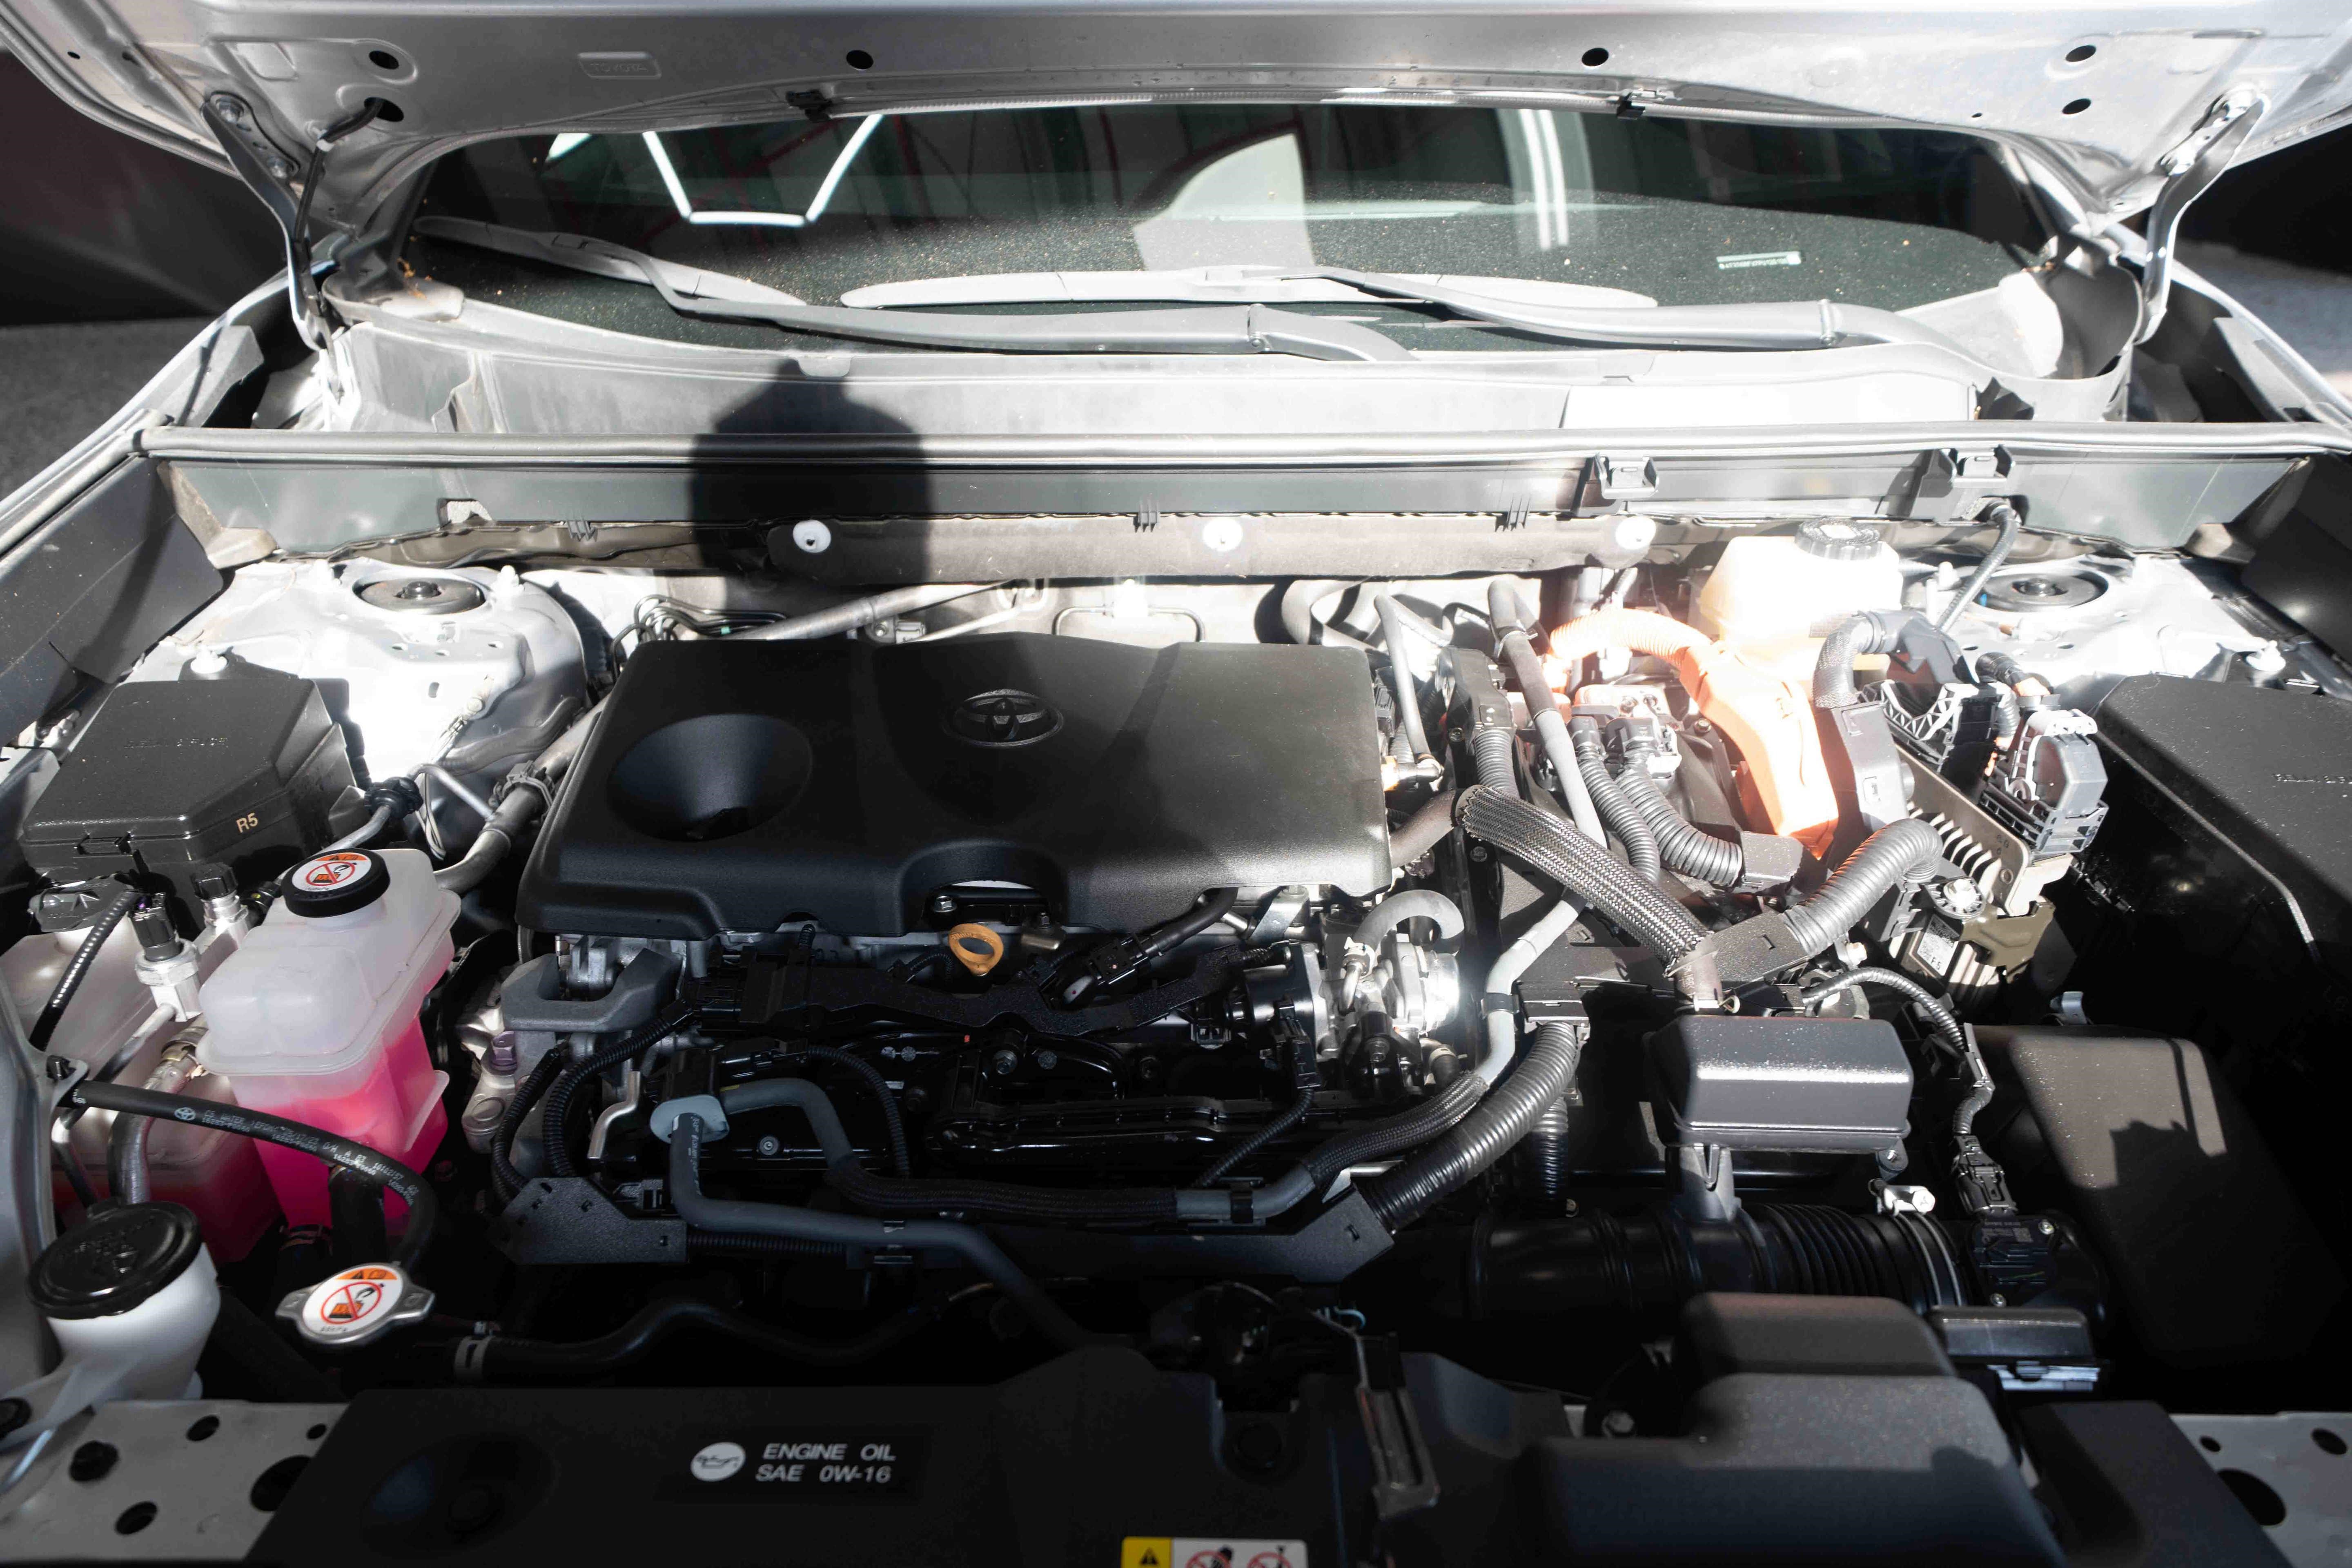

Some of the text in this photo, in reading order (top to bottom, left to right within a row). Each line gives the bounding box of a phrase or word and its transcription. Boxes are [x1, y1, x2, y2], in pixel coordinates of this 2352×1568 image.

[236, 813, 258, 833] R5
[763, 1443, 896, 1461] ENGINE OIL
[755, 1463, 892, 1483] SAE 0W-16
